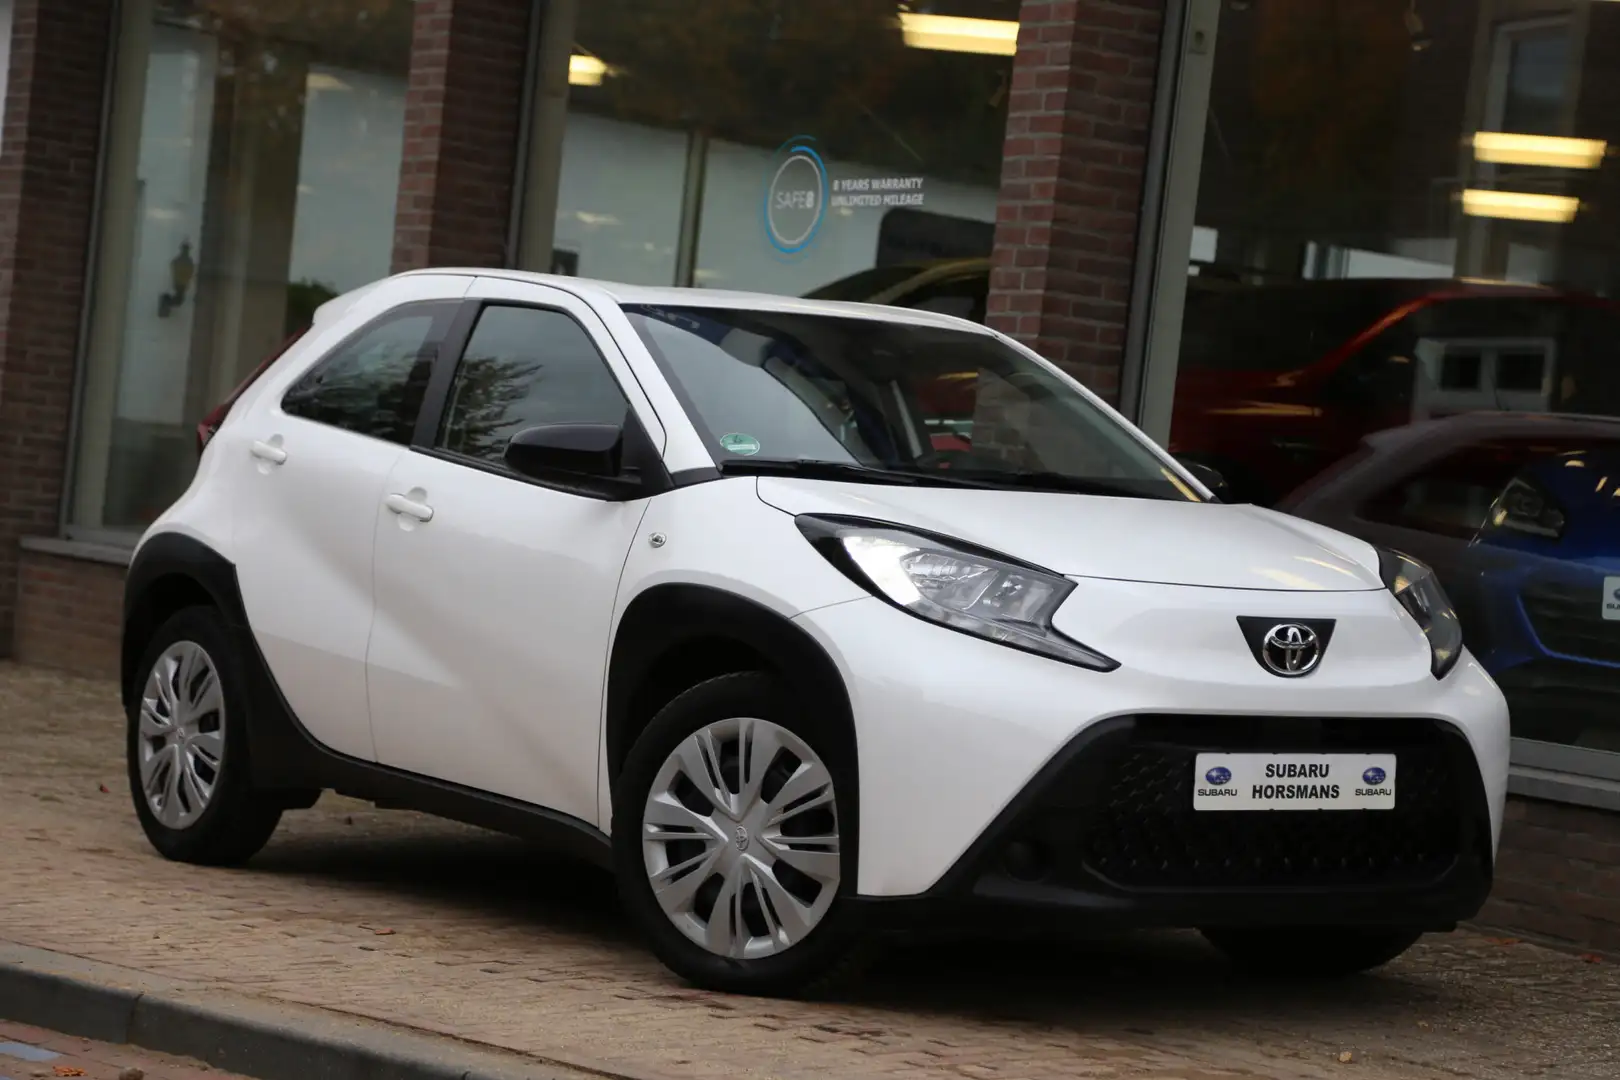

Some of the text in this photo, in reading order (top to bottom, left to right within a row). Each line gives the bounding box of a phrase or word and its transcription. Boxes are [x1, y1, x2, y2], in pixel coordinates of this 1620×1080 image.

[842, 178, 869, 191] YEARS
[872, 177, 924, 189] WARRANTY
[831, 193, 924, 207] UNLIMITED MILEAGE
[1265, 763, 1330, 778] SUBARU
[1198, 788, 1238, 797] SUBARU
[1252, 784, 1340, 799] HORSMANS
[1355, 788, 1392, 796] SUBARU
